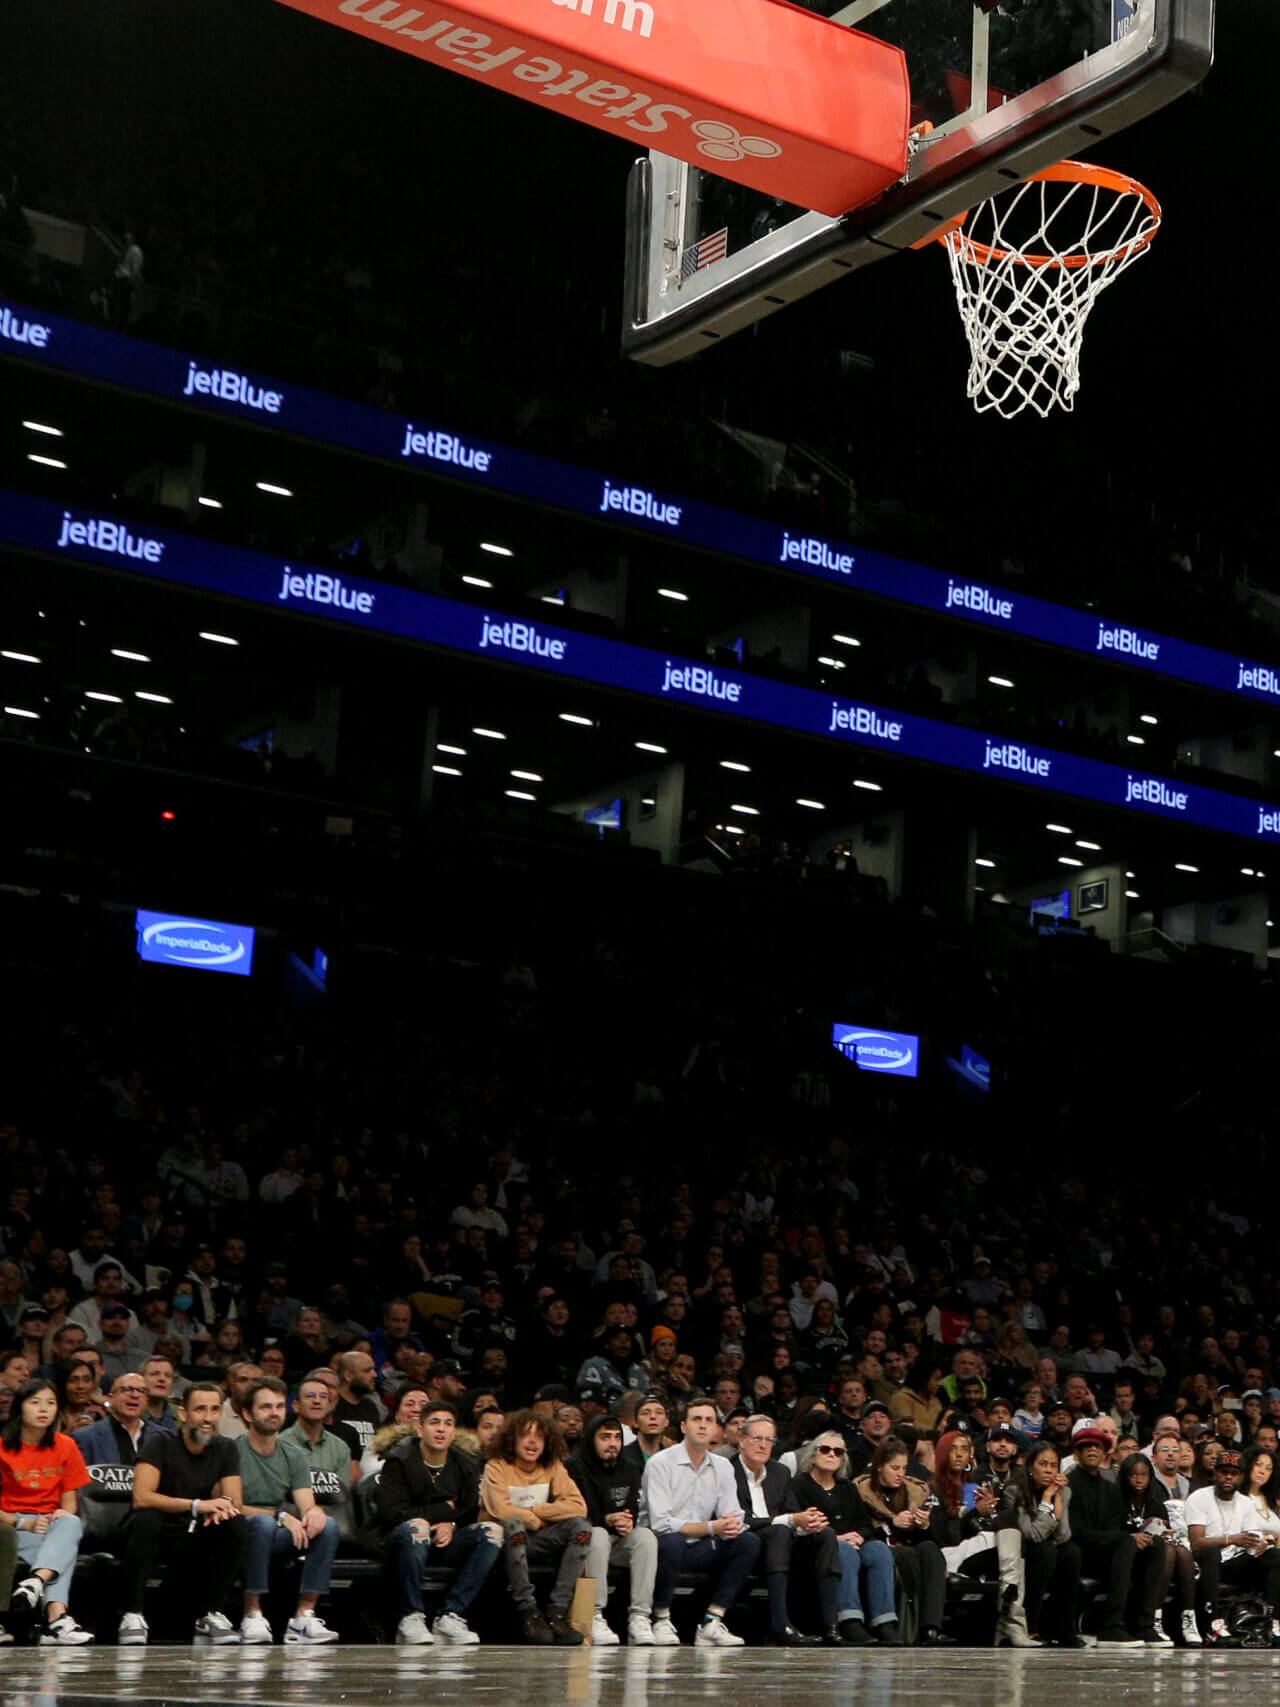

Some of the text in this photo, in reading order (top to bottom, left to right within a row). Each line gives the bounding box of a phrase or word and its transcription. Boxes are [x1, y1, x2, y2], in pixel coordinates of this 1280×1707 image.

[185, 362, 282, 413] jetBlue
[403, 425, 491, 472] jetBlue
[601, 482, 681, 525] jetBlue
[58, 512, 163, 562] jetBlue
[781, 533, 853, 574] jetBlue
[280, 567, 374, 613] jetBlue
[946, 580, 1013, 619] jetBlue
[480, 616, 566, 660] jetBlue
[1097, 623, 1159, 660] jetBlue
[662, 661, 741, 702] jetBlue
[830, 702, 902, 741] jetBlue
[984, 740, 1050, 777] jetBlue
[1126, 776, 1187, 810] jetBlue
[850, 1044, 904, 1060] perialDade
[88, 1467, 135, 1483] QATA
[310, 1471, 340, 1484] TAR
